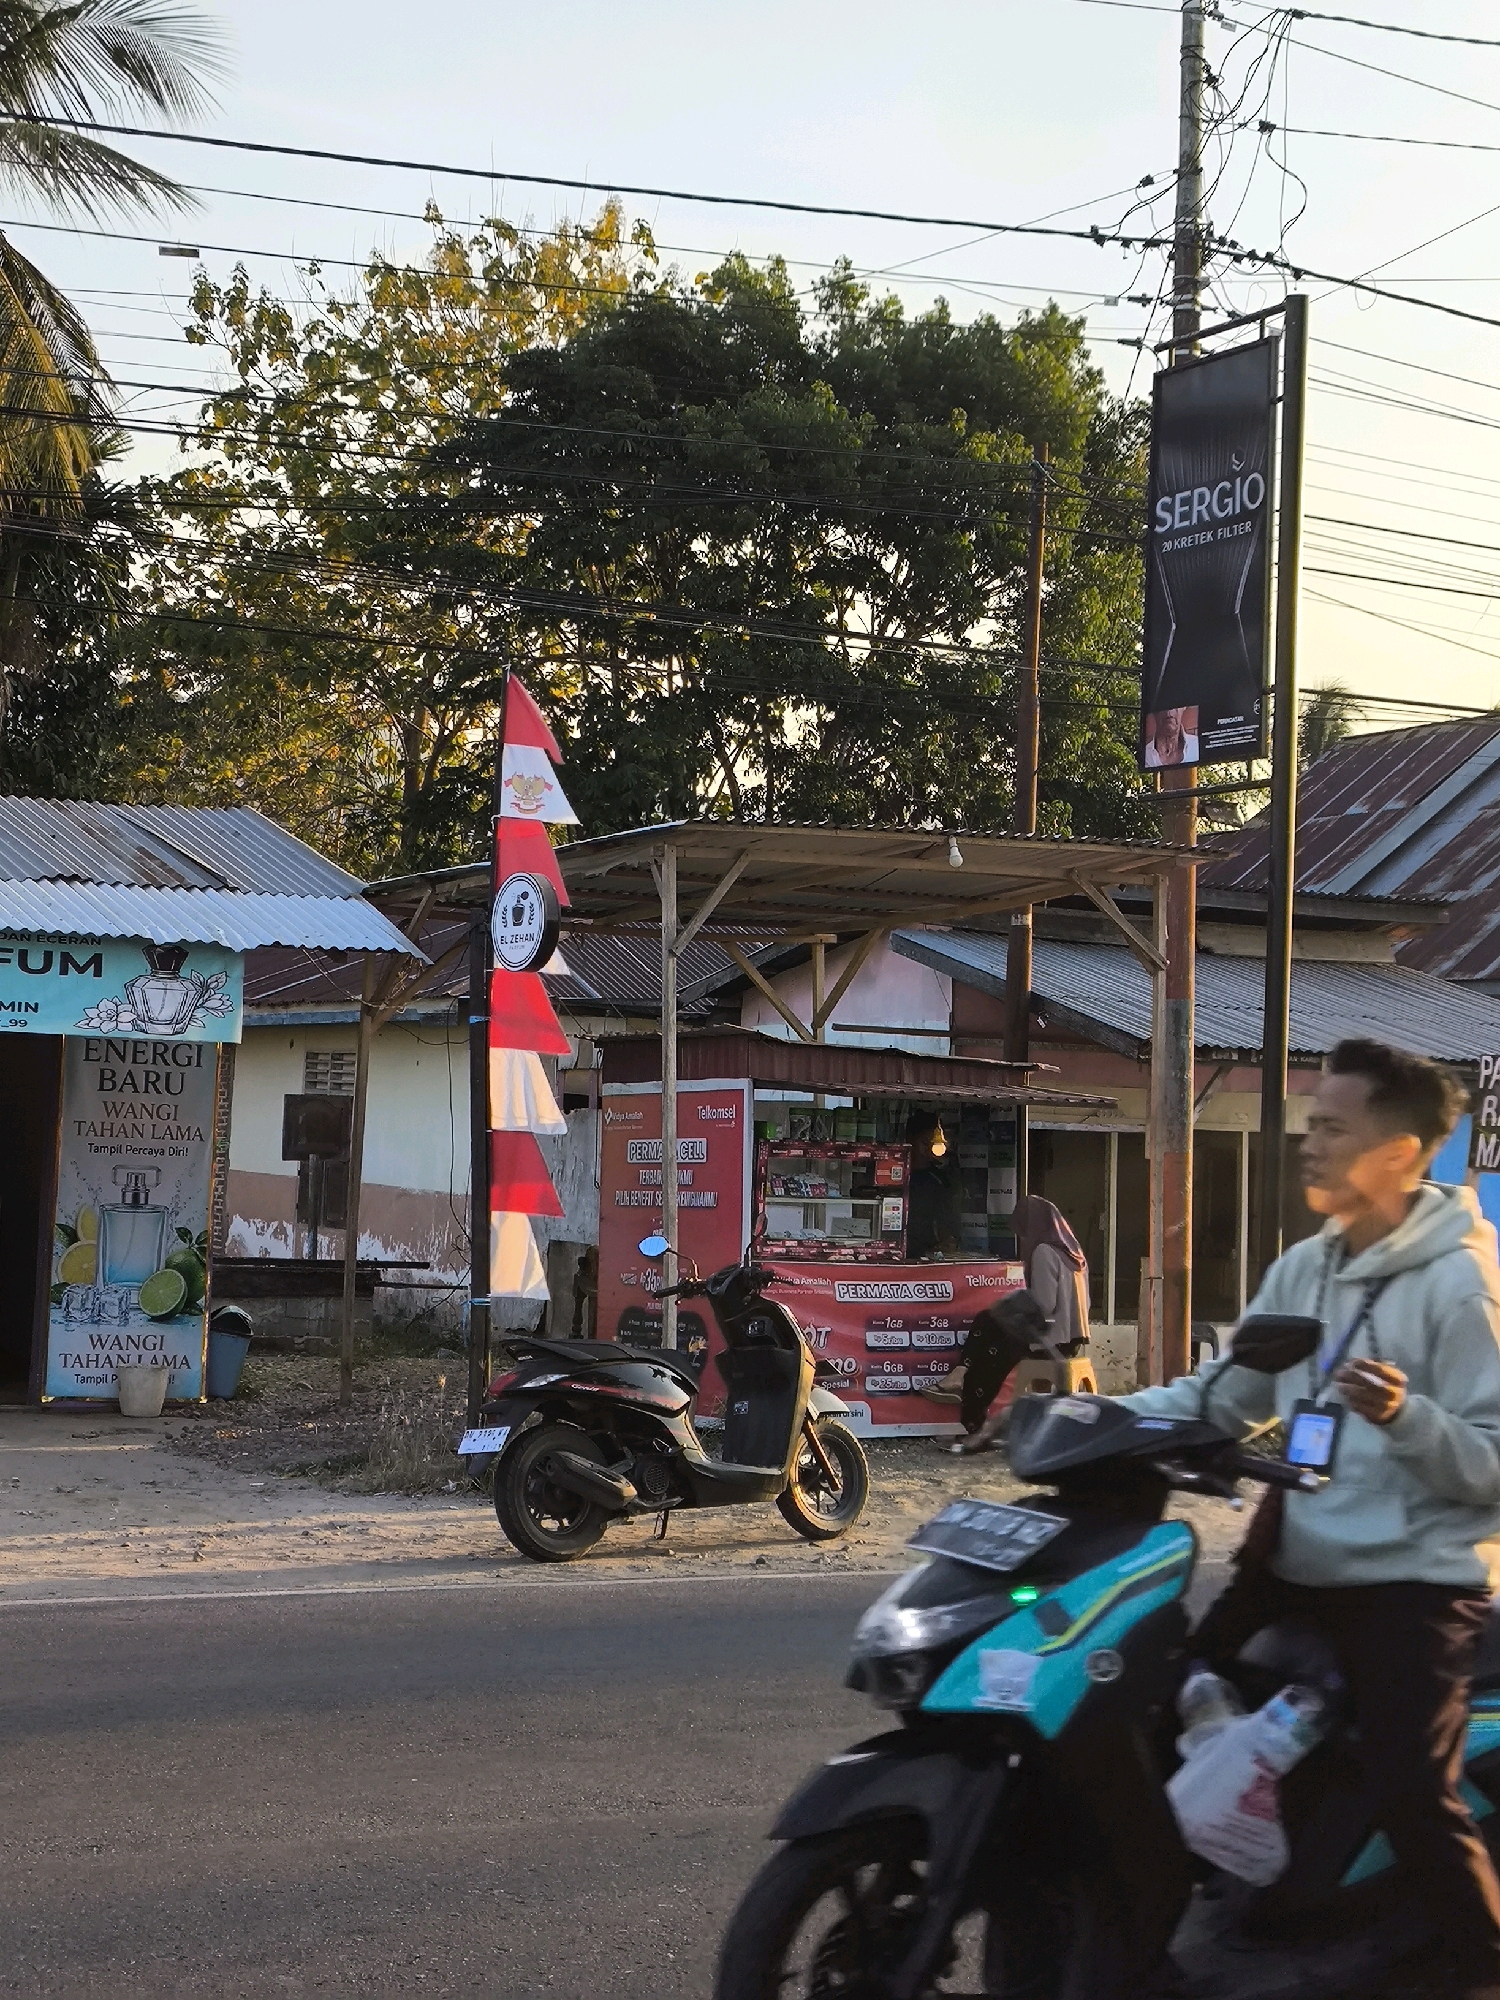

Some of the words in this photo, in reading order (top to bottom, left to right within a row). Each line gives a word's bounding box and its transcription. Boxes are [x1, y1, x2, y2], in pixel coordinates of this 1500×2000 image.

[1154, 472, 1265, 533] SERGIO
[1162, 541, 1173, 553] 20
[1174, 530, 1214, 550] KRETEK
[1217, 520, 1252, 540] FILTER
[36, 934, 101, 946] ECERAN
[501, 936, 508, 944] EL
[510, 933, 534, 943] ZEHAN
[0, 1018, 28, 1028] _99
[83, 1038, 203, 1068] ENERGI
[96, 1068, 187, 1097] BARU
[101, 1100, 179, 1122] WANGI
[697, 1104, 736, 1120] Telkomsel
[1481, 1095, 1500, 1127] R
[73, 1120, 146, 1140] TAHAN
[150, 1122, 205, 1143] LAMA
[87, 1142, 123, 1157] Tampil
[125, 1142, 166, 1158] Percaya
[168, 1143, 189, 1157] Diri!
[680, 1141, 705, 1160] CELL
[800, 1277, 832, 1287] Amaliah
[838, 1283, 912, 1299] PERMATA
[913, 1283, 951, 1299] CELL
[885, 1316, 903, 1329] 1GB
[929, 1316, 949, 1328] 3GB
[87, 1333, 165, 1351] WANGI
[58, 1353, 132, 1369] TAHAN
[883, 1360, 903, 1373] 6GB
[930, 1360, 949, 1372] 6GB
[74, 1373, 108, 1386] Tampil
[821, 1380, 850, 1391] Spesial
